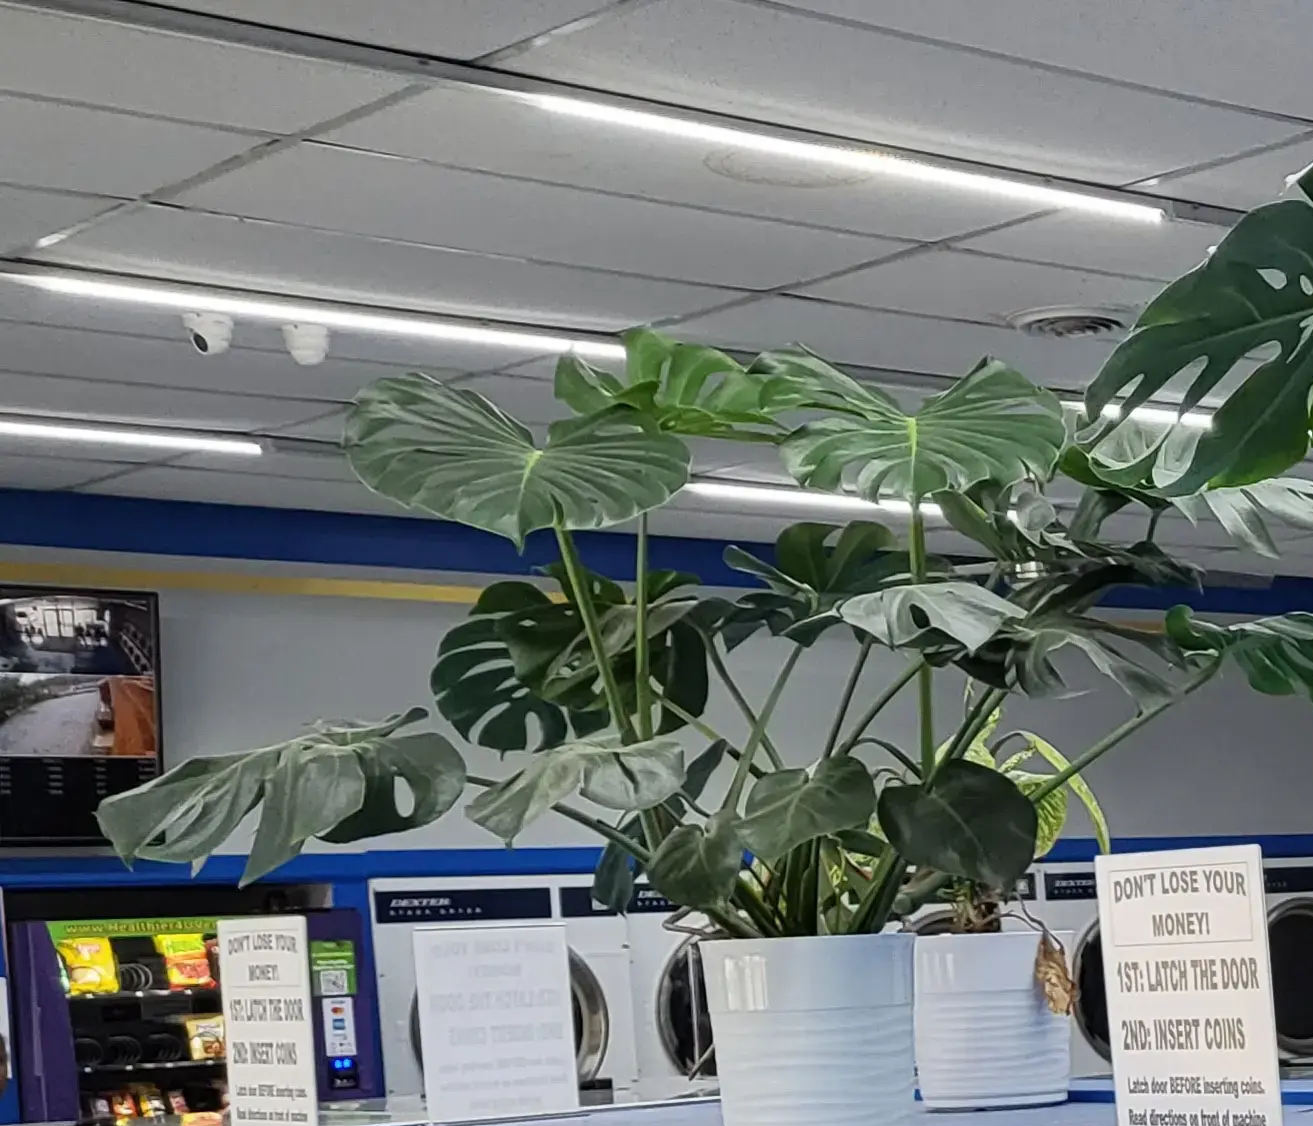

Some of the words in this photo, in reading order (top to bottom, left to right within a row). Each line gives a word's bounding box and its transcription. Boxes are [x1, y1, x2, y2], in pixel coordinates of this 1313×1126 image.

[1113, 873, 1156, 904] DON'T
[1160, 870, 1199, 895] LOSE
[1202, 869, 1247, 897] YOUR
[389, 897, 451, 908] DEXTER
[1152, 912, 1210, 937] MONEY!
[228, 935, 250, 955] DON'T
[252, 934, 273, 951] LOSE
[275, 934, 298, 954] YOUR
[1117, 961, 1145, 993] 1ST:
[1146, 959, 1188, 992] LATCH
[1190, 958, 1218, 991] THE
[1220, 957, 1260, 990] DOOR
[246, 999, 267, 1022] LATCH
[269, 999, 283, 1022] THE
[284, 999, 304, 1022] DOOR
[1121, 1019, 1151, 1050] 2ND:
[1153, 1018, 1200, 1050] INSERT
[1204, 1017, 1246, 1050] COINS
[249, 1042, 274, 1065] INSERT
[275, 1042, 298, 1065] COINS
[1127, 1076, 1149, 1094] Latch
[1151, 1076, 1168, 1094] door
[1169, 1076, 1202, 1094] BEFORE
[1203, 1076, 1239, 1099] inserting
[1240, 1076, 1265, 1095] coins.
[1128, 1108, 1148, 1126] Read
[1149, 1109, 1188, 1126] directions
[1189, 1112, 1199, 1126] on
[1200, 1109, 1220, 1126] front
[1222, 1109, 1231, 1126] of
